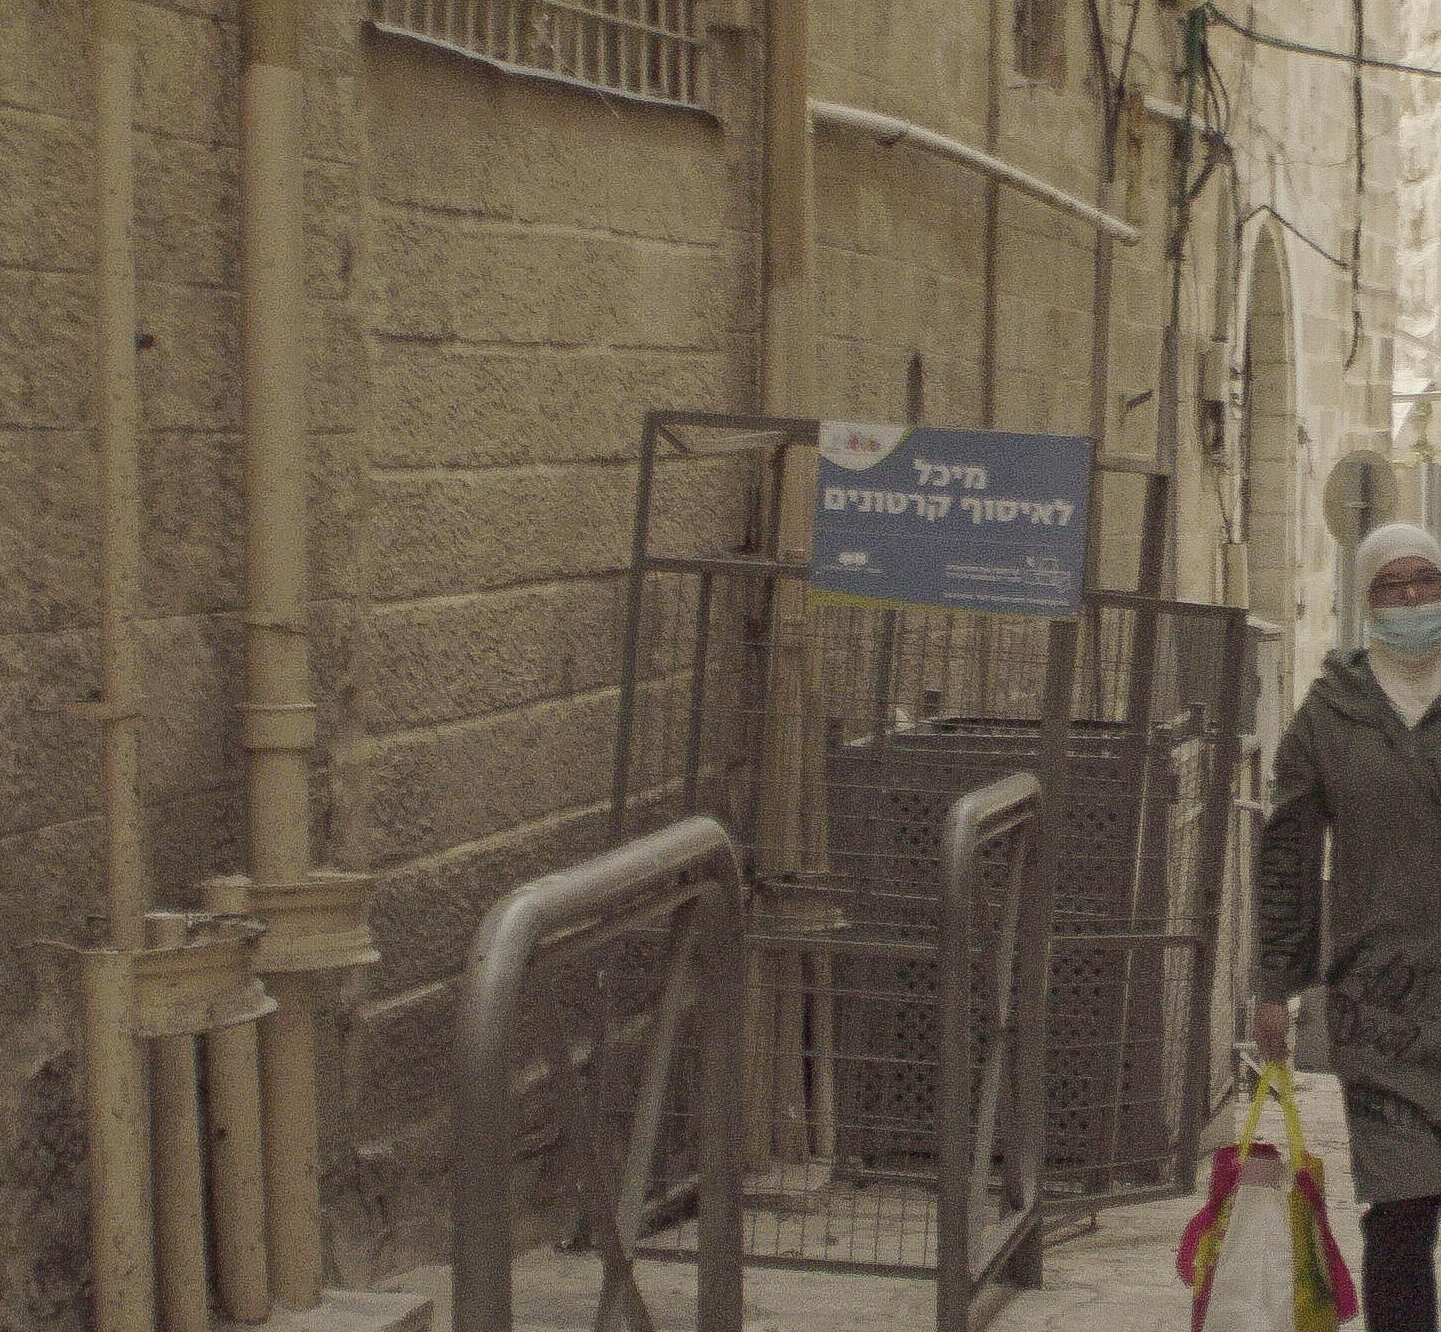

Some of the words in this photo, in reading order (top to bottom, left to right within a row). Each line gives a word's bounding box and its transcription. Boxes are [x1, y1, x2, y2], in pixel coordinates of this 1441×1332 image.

[912, 457, 989, 490] מיכל
[823, 486, 952, 523] קרטונים
[960, 496, 1074, 527] לאיסוף
